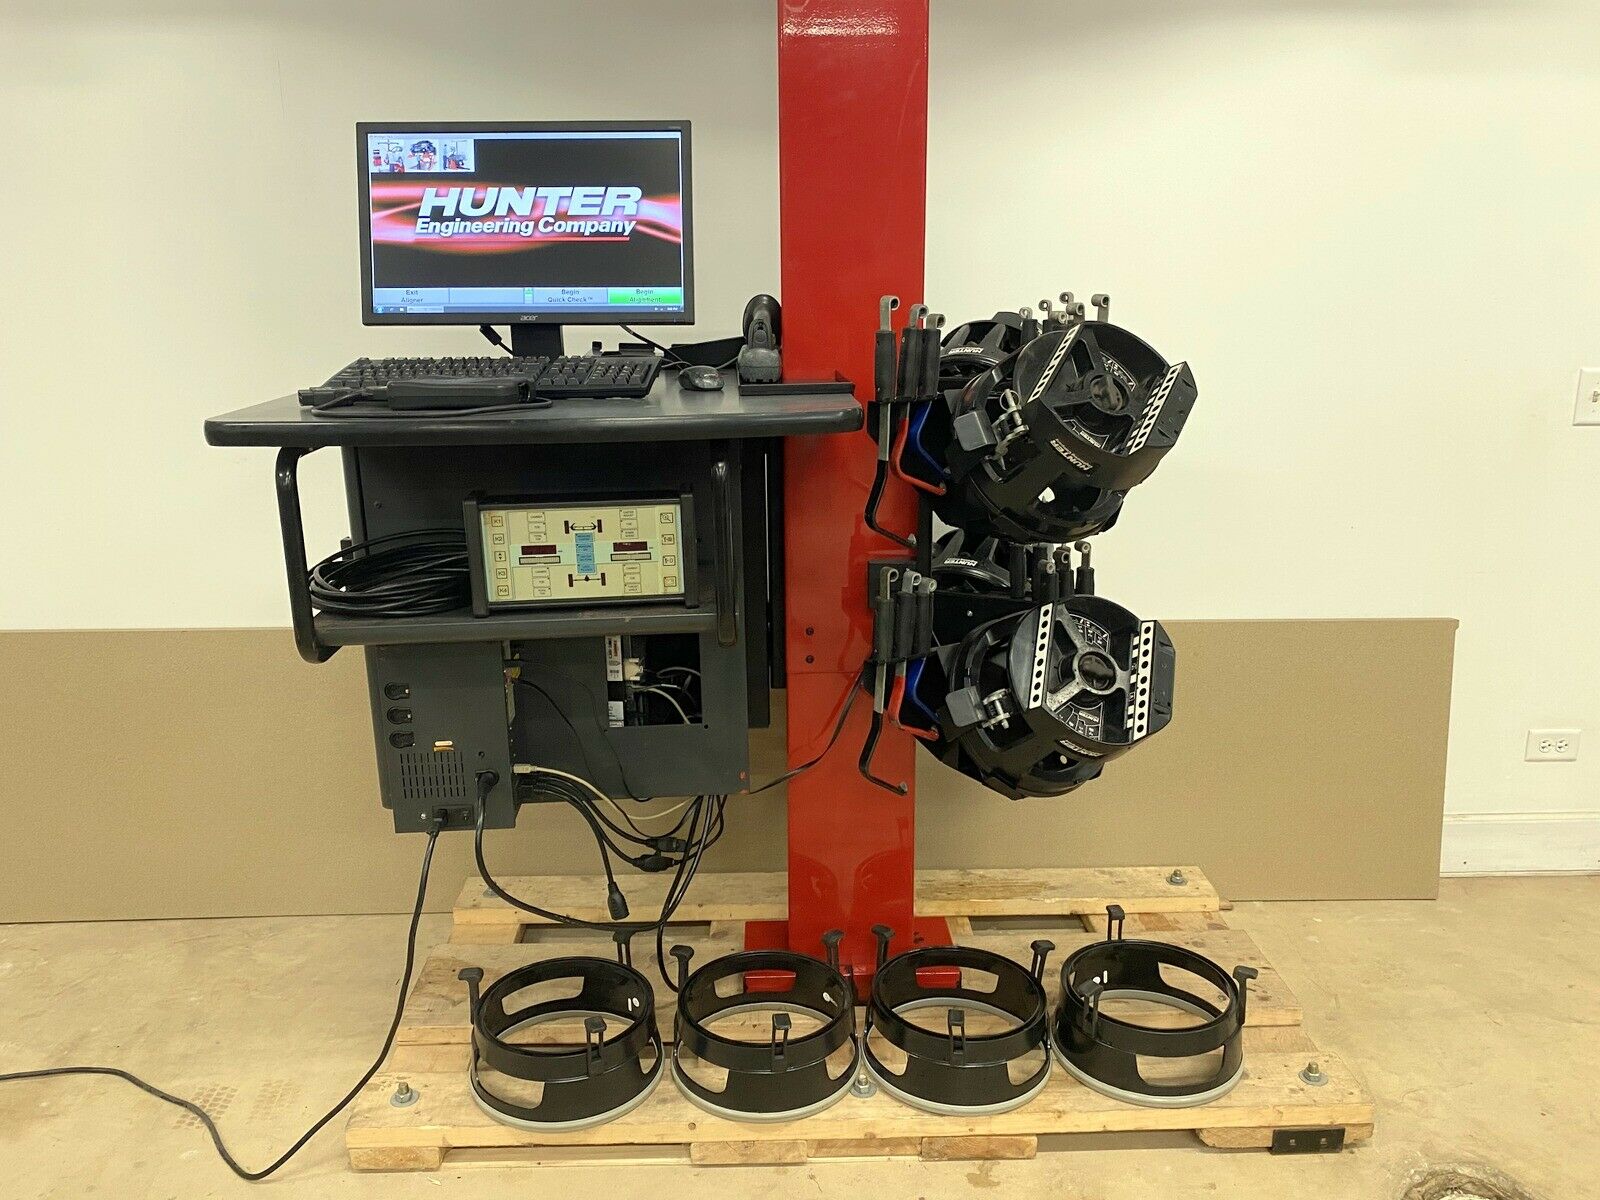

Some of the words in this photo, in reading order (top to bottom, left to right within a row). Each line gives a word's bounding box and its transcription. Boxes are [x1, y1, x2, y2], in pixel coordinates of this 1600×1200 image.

[418, 186, 642, 216] HUNTER
[415, 217, 535, 236] Engineering
[538, 216, 637, 236] Company
[636, 288, 654, 296] Begin
[1050, 440, 1093, 471] HUNTER
